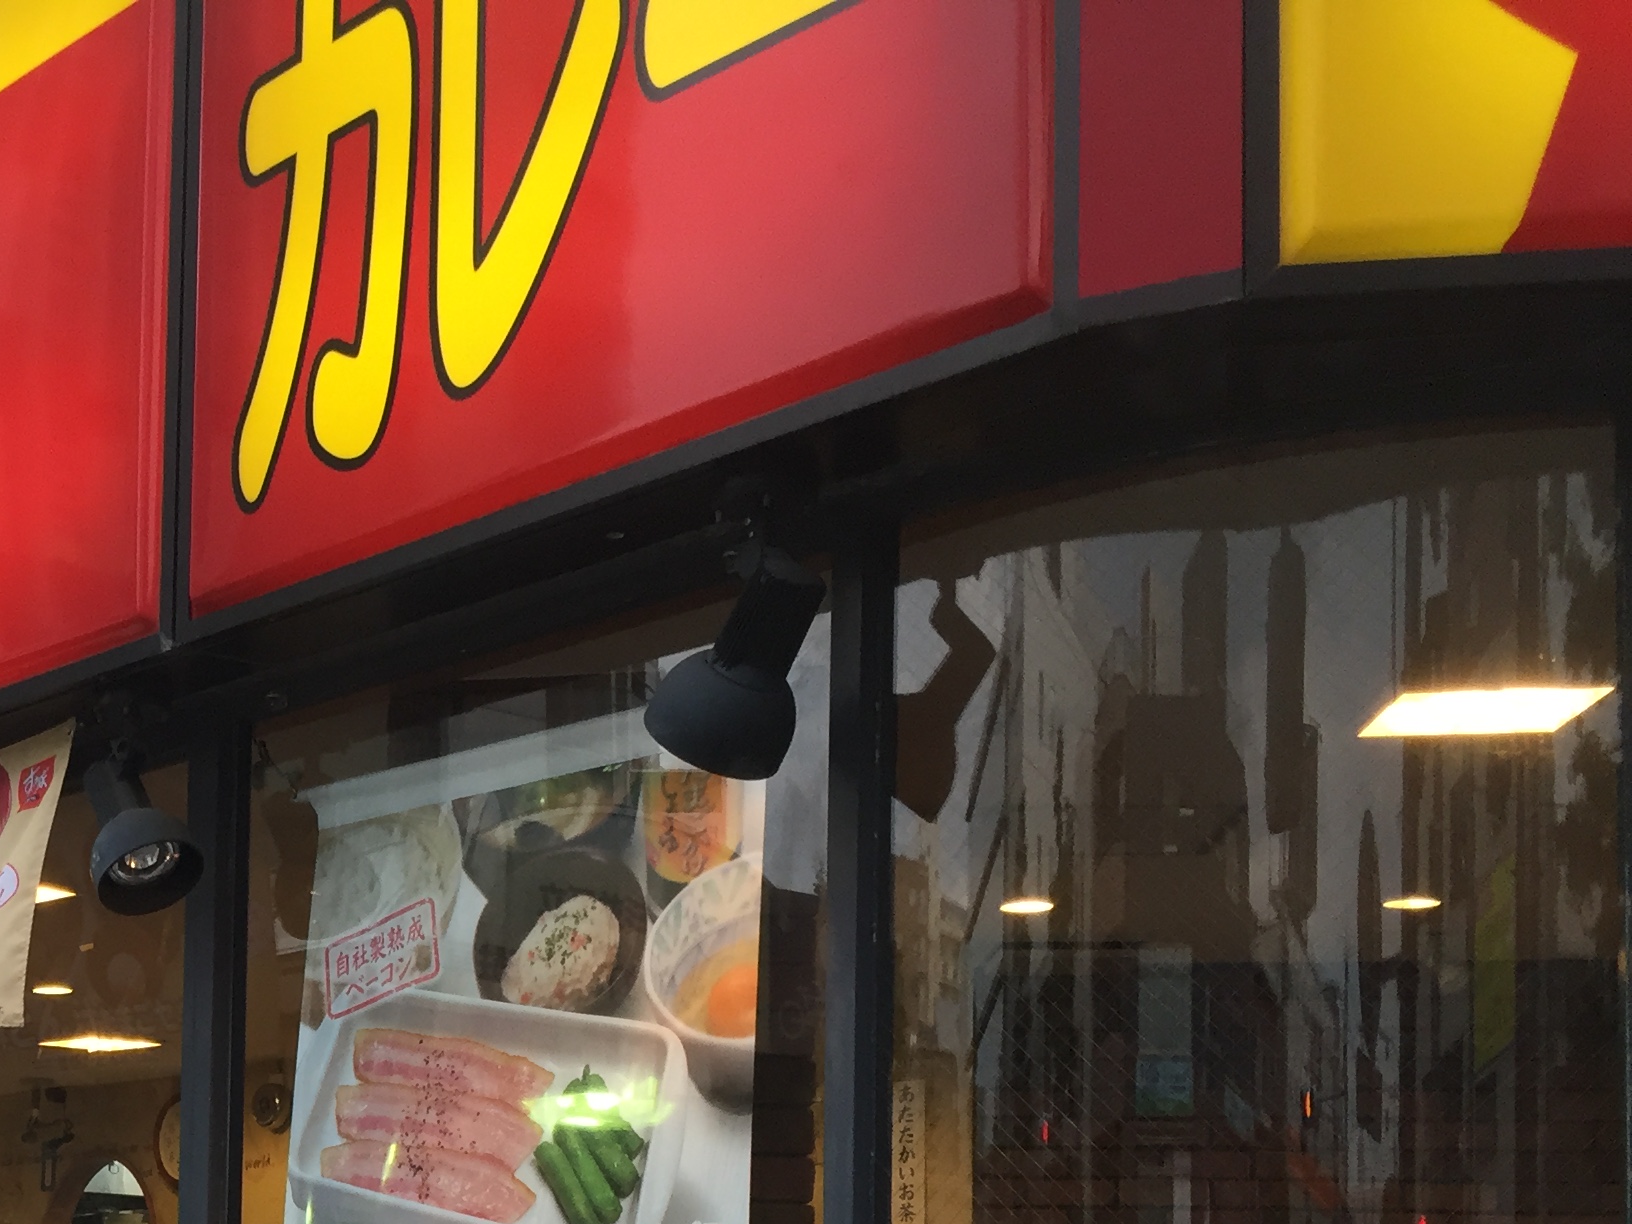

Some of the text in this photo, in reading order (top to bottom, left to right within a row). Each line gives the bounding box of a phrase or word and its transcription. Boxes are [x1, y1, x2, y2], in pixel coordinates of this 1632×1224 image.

[336, 914, 426, 979] 自社製熟成
[346, 955, 413, 996] ベーコン
[898, 1083, 917, 1222] あたたかいお茶
